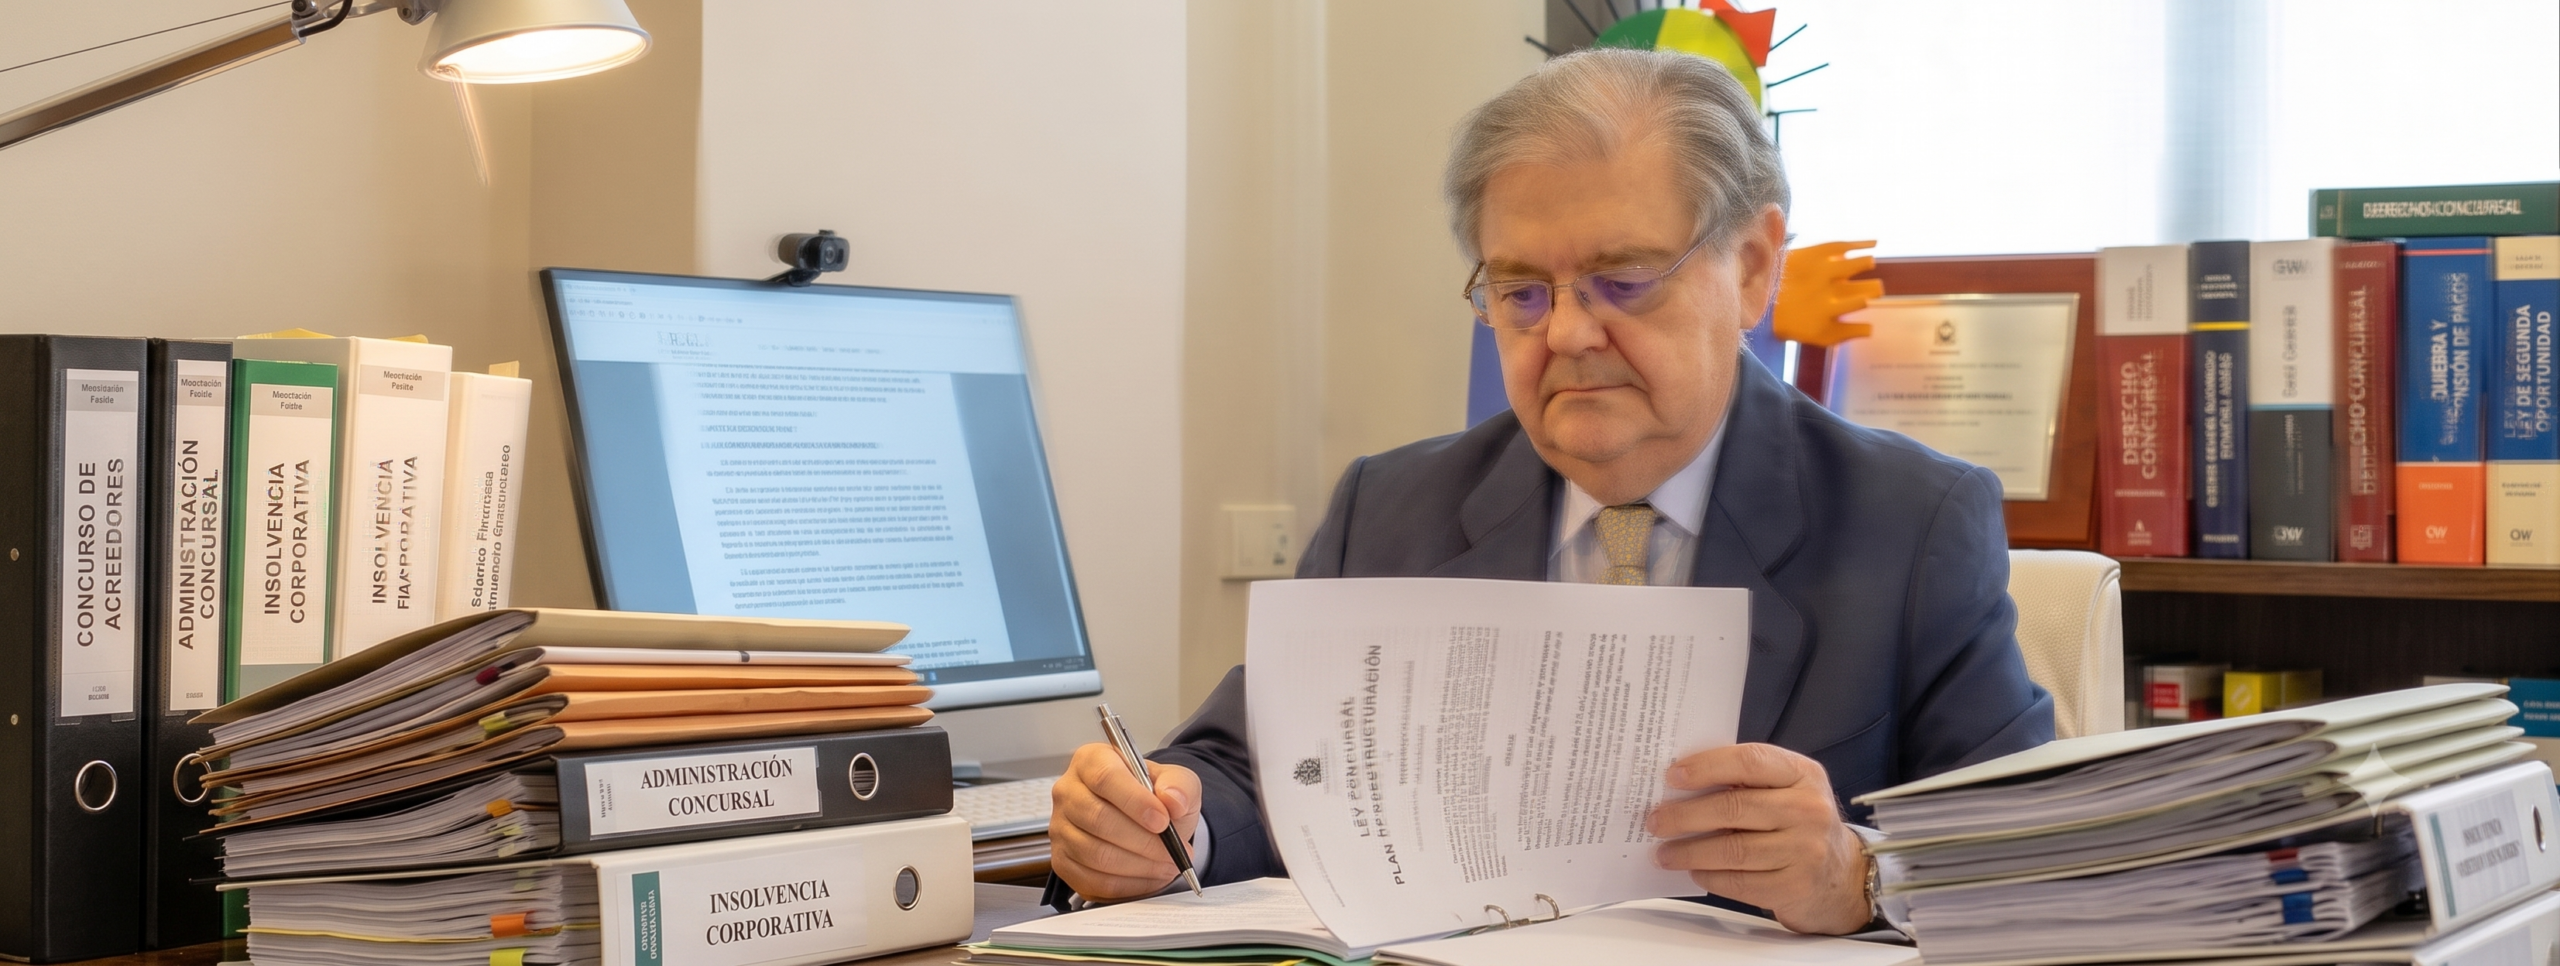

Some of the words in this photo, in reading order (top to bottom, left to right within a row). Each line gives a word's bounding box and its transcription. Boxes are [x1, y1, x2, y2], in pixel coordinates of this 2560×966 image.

[2516, 304, 2531, 382] SEGUNDA
[2536, 310, 2551, 432] OPORTUNIDAD
[2120, 361, 2139, 465] DERECHO
[79, 463, 96, 495] DE
[372, 459, 394, 604] INSOLVENCIA
[77, 504, 96, 647] CONCURSO
[105, 458, 124, 631] ACREEDORES
[178, 440, 199, 650] ADMINISTRACIÓN
[200, 469, 219, 620] CONCURSAL
[264, 462, 285, 615] INSOLVENCIA
[290, 459, 310, 624] CORPORATIVA
[640, 754, 793, 790] ADMINISTRACIÓN
[668, 789, 775, 817] CONCURSAL
[709, 879, 830, 915] INSOLVENCIA
[1384, 843, 1406, 885] PLAN
[706, 909, 834, 946] CORPORATIVA
